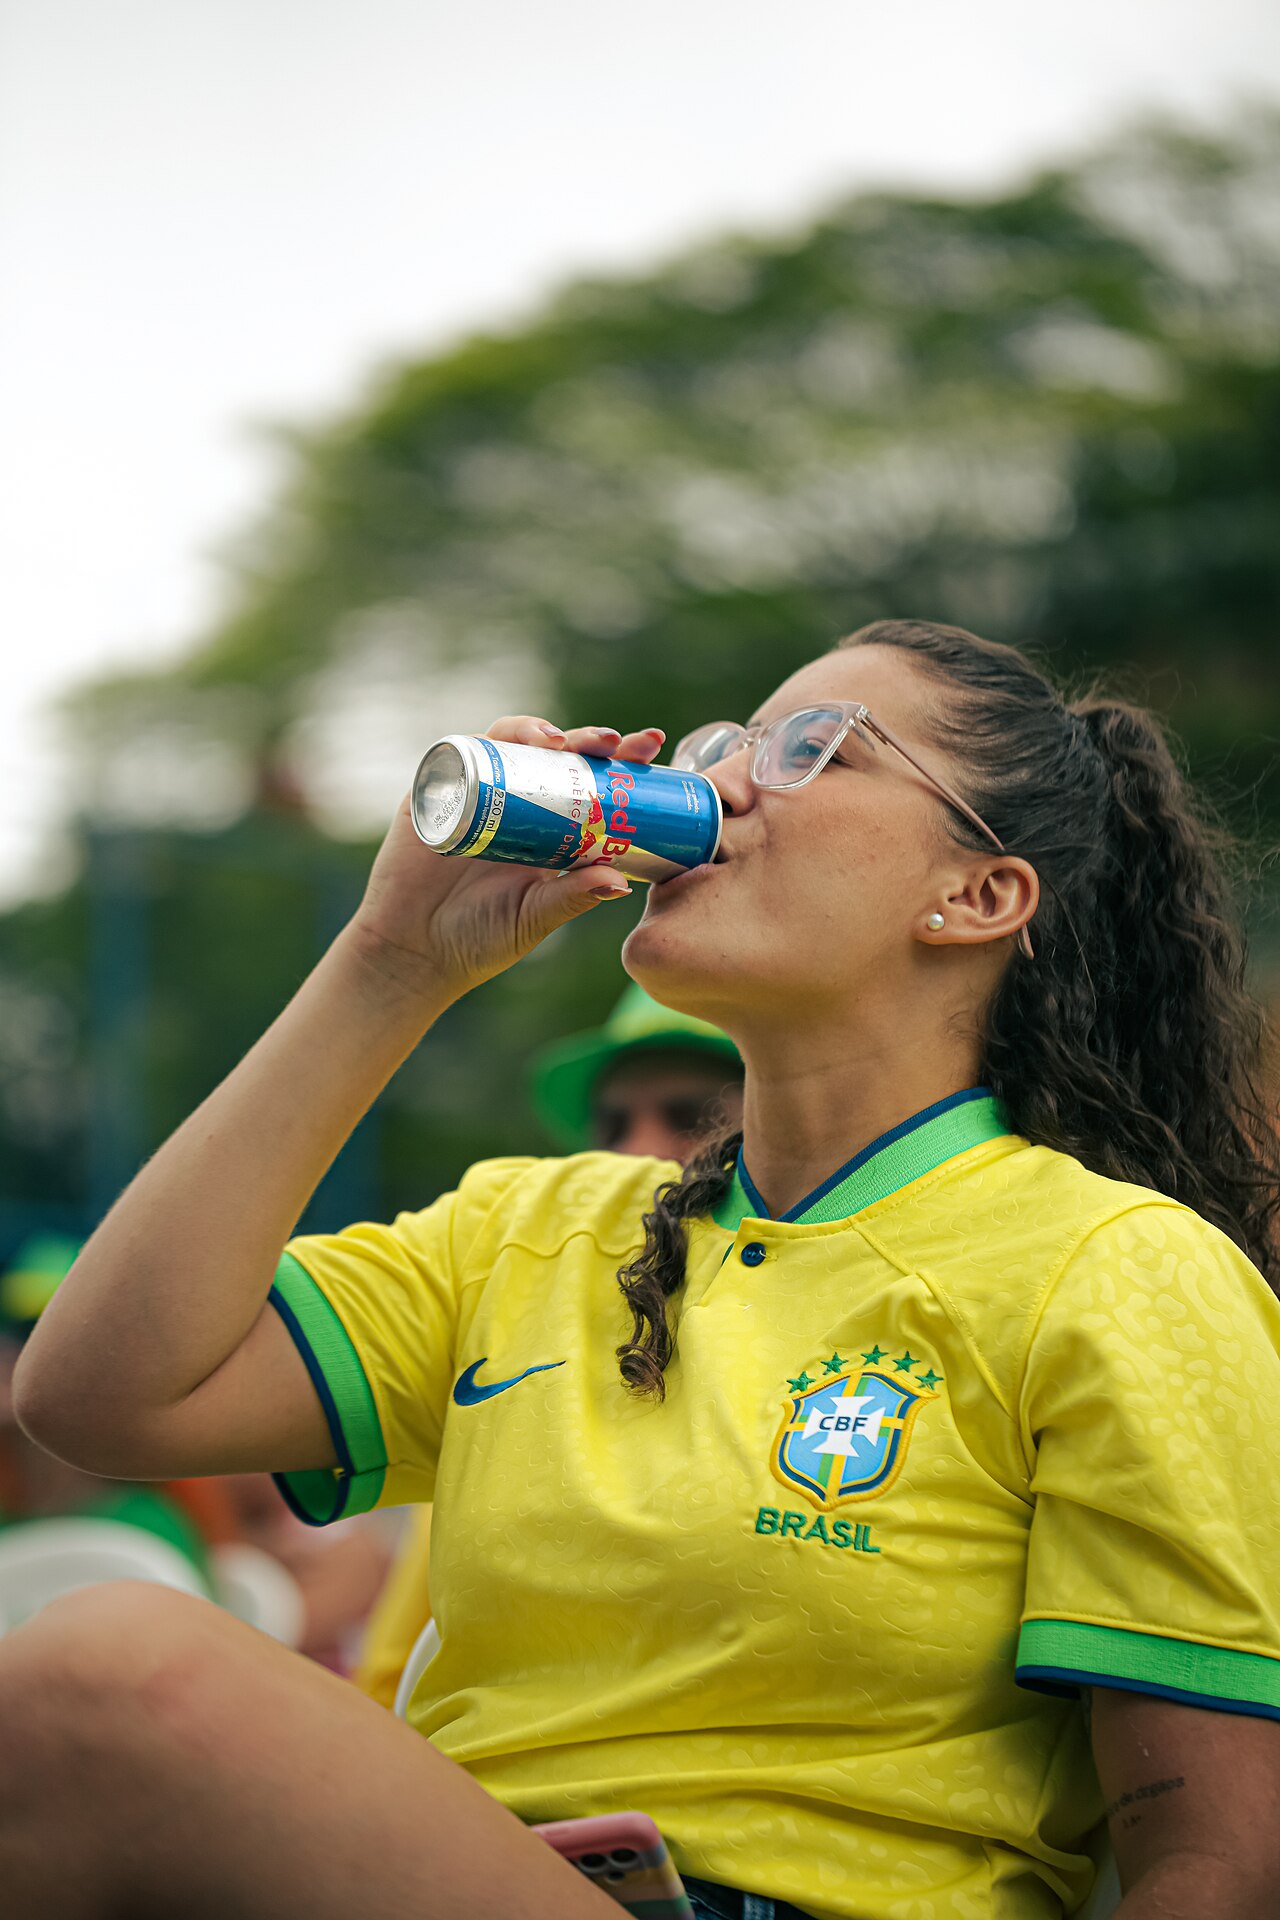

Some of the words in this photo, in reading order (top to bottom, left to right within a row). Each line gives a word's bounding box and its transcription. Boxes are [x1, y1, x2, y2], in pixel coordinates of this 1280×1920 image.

[491, 791, 504, 816] 250
[568, 768, 582, 829] ENERGY
[606, 770, 636, 833] Red
[485, 819, 496, 832] ml
[591, 836, 632, 866] Bu
[818, 1415, 868, 1433] CBF
[755, 1506, 881, 1553] BRASIL
